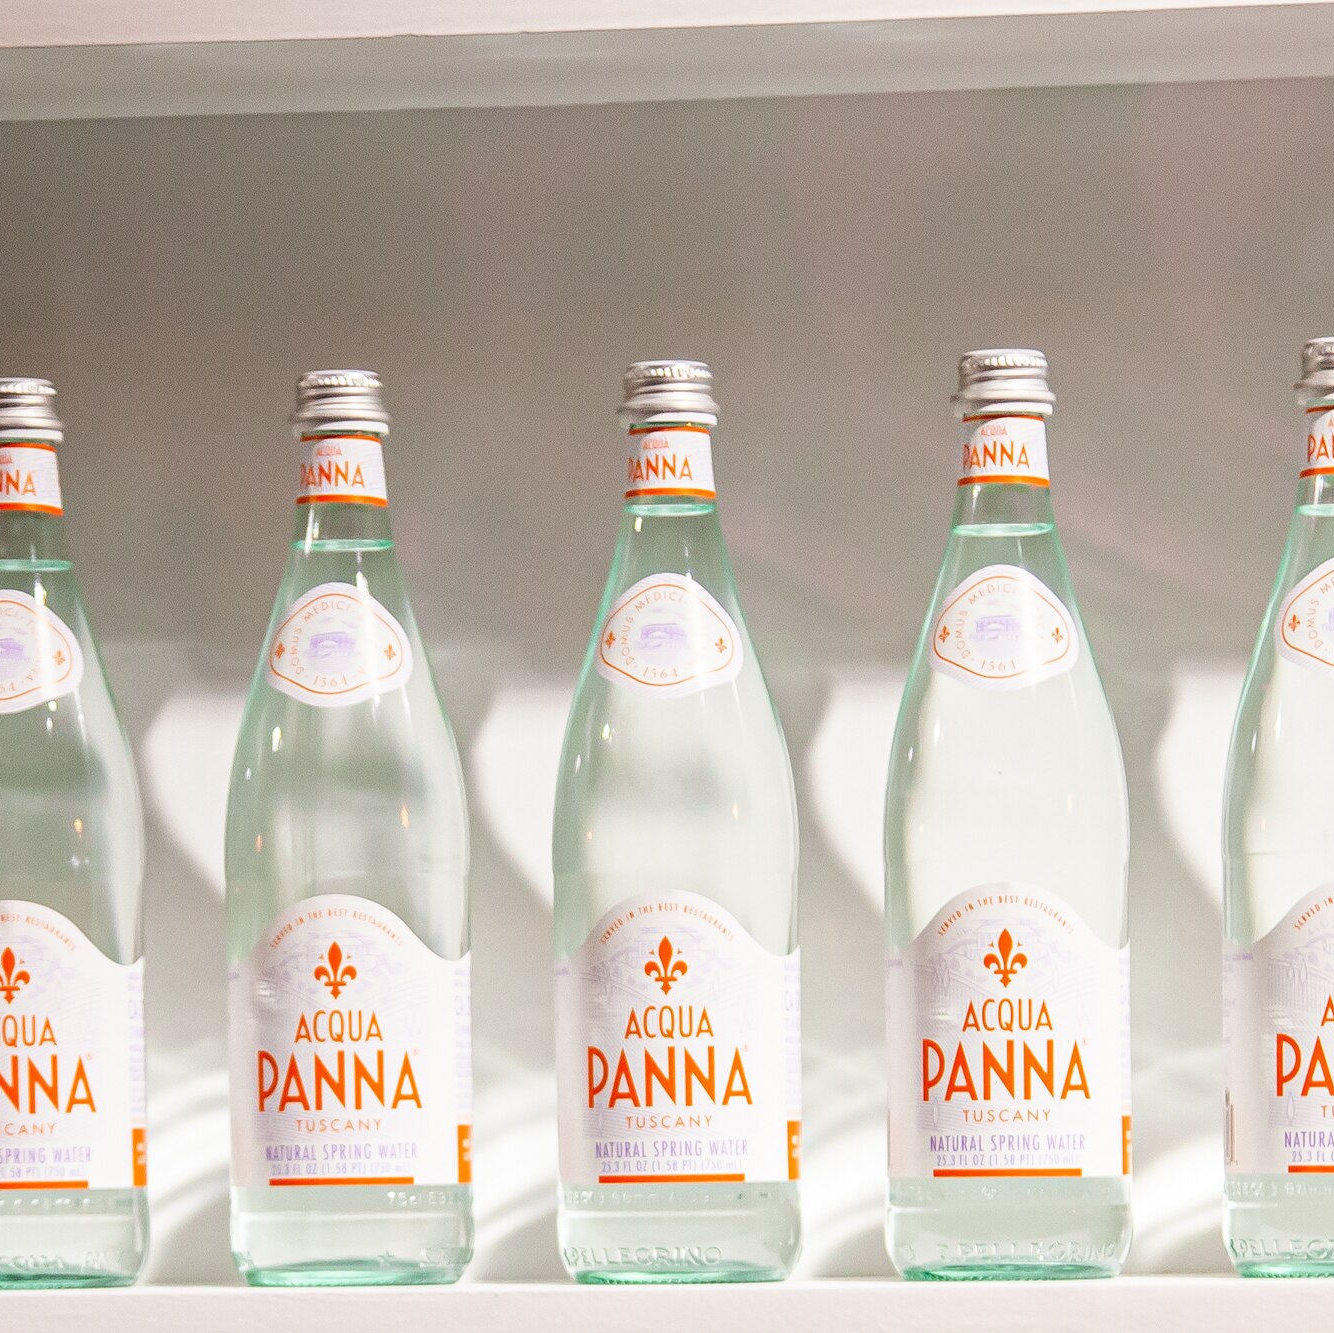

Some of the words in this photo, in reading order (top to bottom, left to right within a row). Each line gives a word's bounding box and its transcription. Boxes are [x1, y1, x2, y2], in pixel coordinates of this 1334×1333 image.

[625, 1006, 713, 1039] ACQUA
[963, 998, 1052, 1032] ACQUA
[295, 1010, 382, 1042] ACQUA
[587, 1046, 752, 1108] PANNA
[923, 1039, 1090, 1102] PANNA
[258, 1050, 421, 1112] PANNA
[295, 1119, 380, 1133] TUSCANY
[625, 1116, 711, 1131] TUSCANY
[963, 1109, 1049, 1124] TUSCANY
[264, 1146, 319, 1162] NATURAL
[323, 1143, 371, 1159] SPRING
[377, 1143, 419, 1159] WATER
[594, 1142, 651, 1159] NATURAL
[655, 1140, 702, 1157] SPRING
[708, 1140, 750, 1156] WATER
[928, 1136, 986, 1153] NATURAL
[990, 1135, 1039, 1152] SPRING
[1044, 1135, 1087, 1150] WATER
[52, 1146, 93, 1165] WATER
